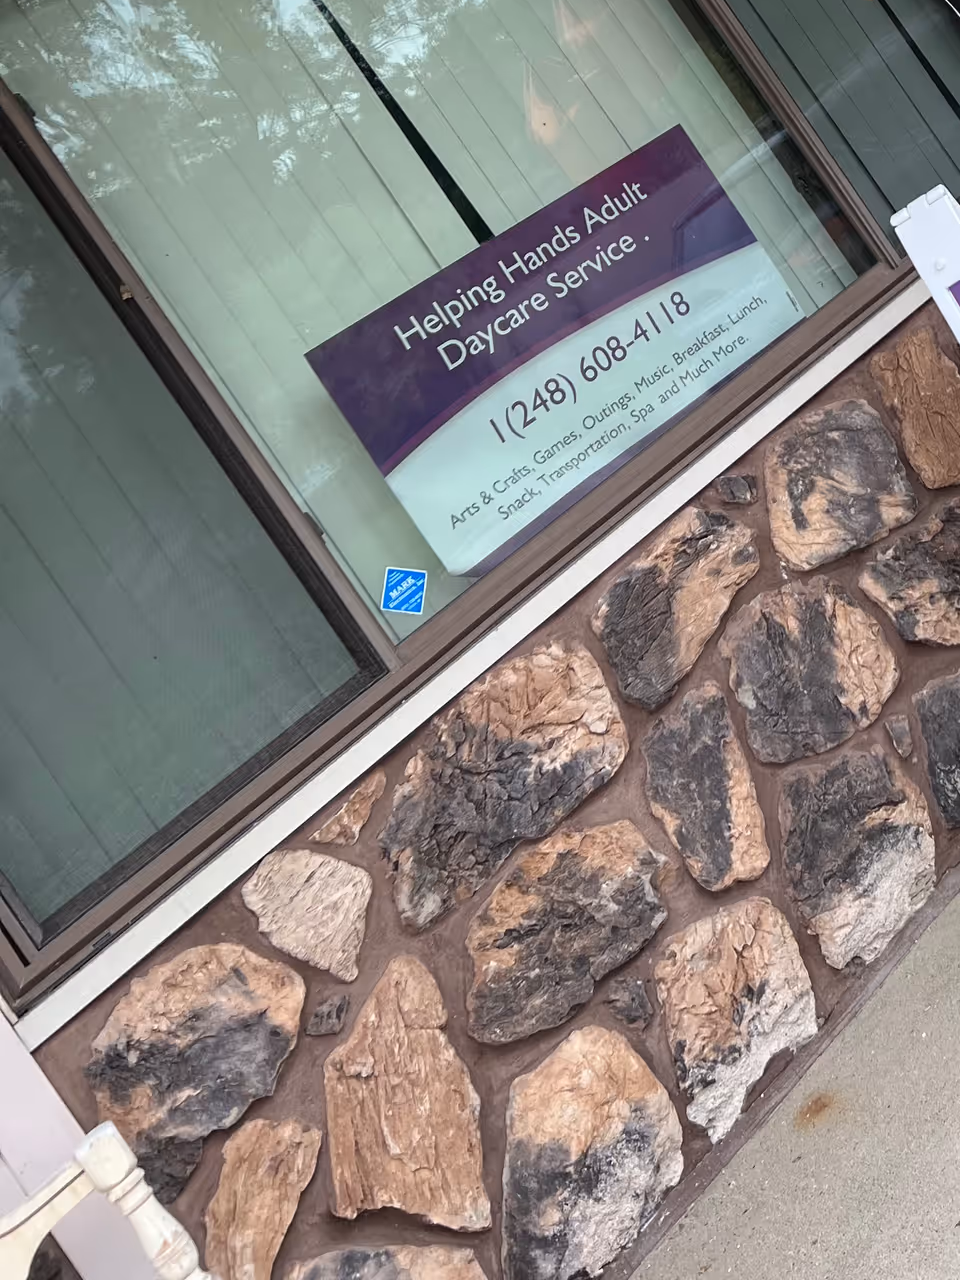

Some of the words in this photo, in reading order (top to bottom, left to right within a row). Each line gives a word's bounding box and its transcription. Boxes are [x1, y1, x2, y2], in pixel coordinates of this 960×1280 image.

[393, 276, 505, 351] Helping
[498, 225, 581, 283] Hands
[583, 182, 647, 234] Adult
[437, 292, 549, 370] Daycare
[546, 235, 636, 299] Service
[580, 291, 690, 382] 608-4118
[449, 502, 480, 530] Arts
[480, 491, 494, 505] &
[492, 465, 536, 494] Crafts,
[533, 430, 582, 465] Games,
[582, 392, 636, 430] Outings,
[634, 363, 674, 394] Music,
[672, 322, 729, 366] Breakfast,
[727, 295, 768, 325] Lunch,
[497, 488, 543, 520] Snack,
[536, 422, 631, 487] Transportation,
[630, 404, 655, 424] Spa
[658, 380, 681, 404] and
[679, 358, 714, 387] Much
[712, 334, 749, 362] More.
[389, 575, 416, 600] MARK
